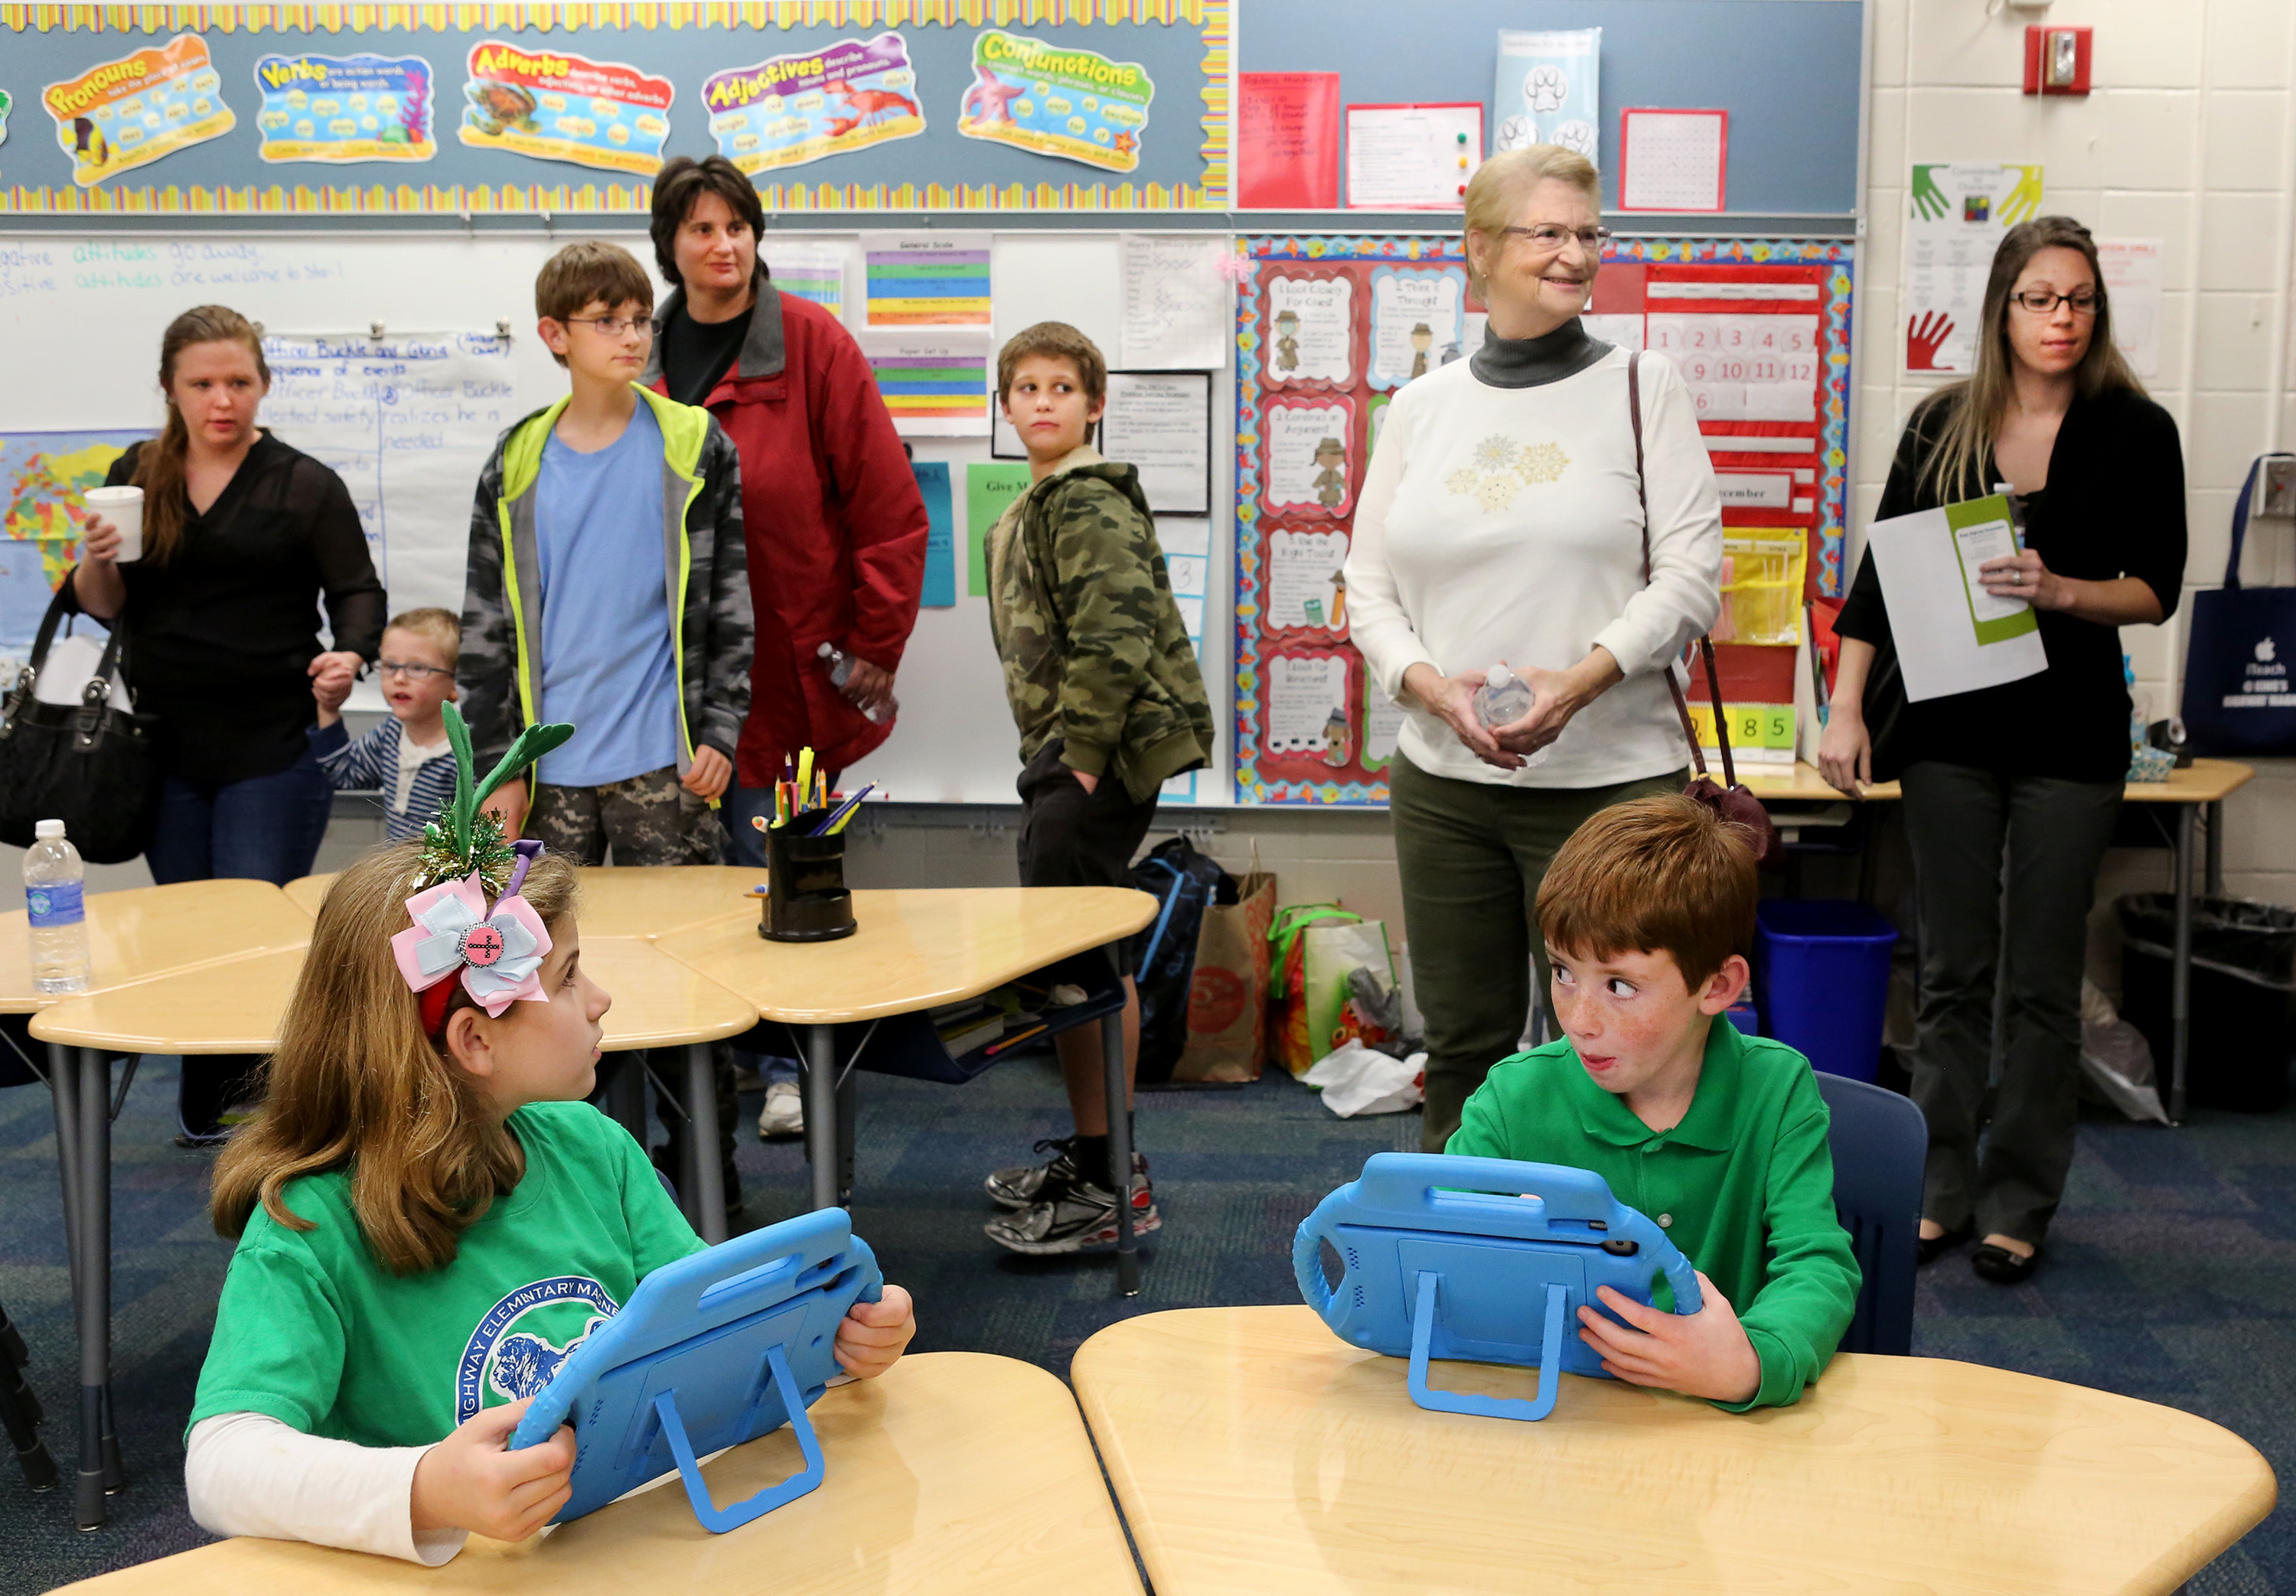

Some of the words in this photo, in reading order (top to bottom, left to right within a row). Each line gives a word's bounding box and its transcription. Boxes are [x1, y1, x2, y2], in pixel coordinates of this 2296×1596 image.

[475, 47, 570, 77] Adverbs
[983, 34, 1137, 86] Conjunctions
[261, 58, 328, 89] Verbs
[709, 57, 825, 107] Adjectives
[49, 60, 147, 114] Pronouns
[0, 240, 55, 278] gative
[73, 239, 158, 264] attitudes
[169, 242, 197, 269] go
[74, 270, 164, 288] attitudes
[171, 271, 205, 287] are
[1660, 332, 1668, 348] 1
[1694, 331, 1706, 348] 2
[1730, 329, 1743, 347] 3
[1762, 333, 1773, 348] 4
[1791, 334, 1802, 350] 5
[1694, 363, 1706, 380] 9
[1721, 362, 1743, 379] 10
[1755, 362, 1776, 379] 11
[1790, 363, 1811, 381] 12
[986, 480, 1013, 492] Give
[1016, 480, 1029, 492] M
[1718, 487, 1766, 498] cember
[1178, 561, 1193, 589] 3
[1743, 718, 1757, 738] 8
[1771, 717, 1785, 737] 5
[463, 1340, 487, 1422] IGHWAY
